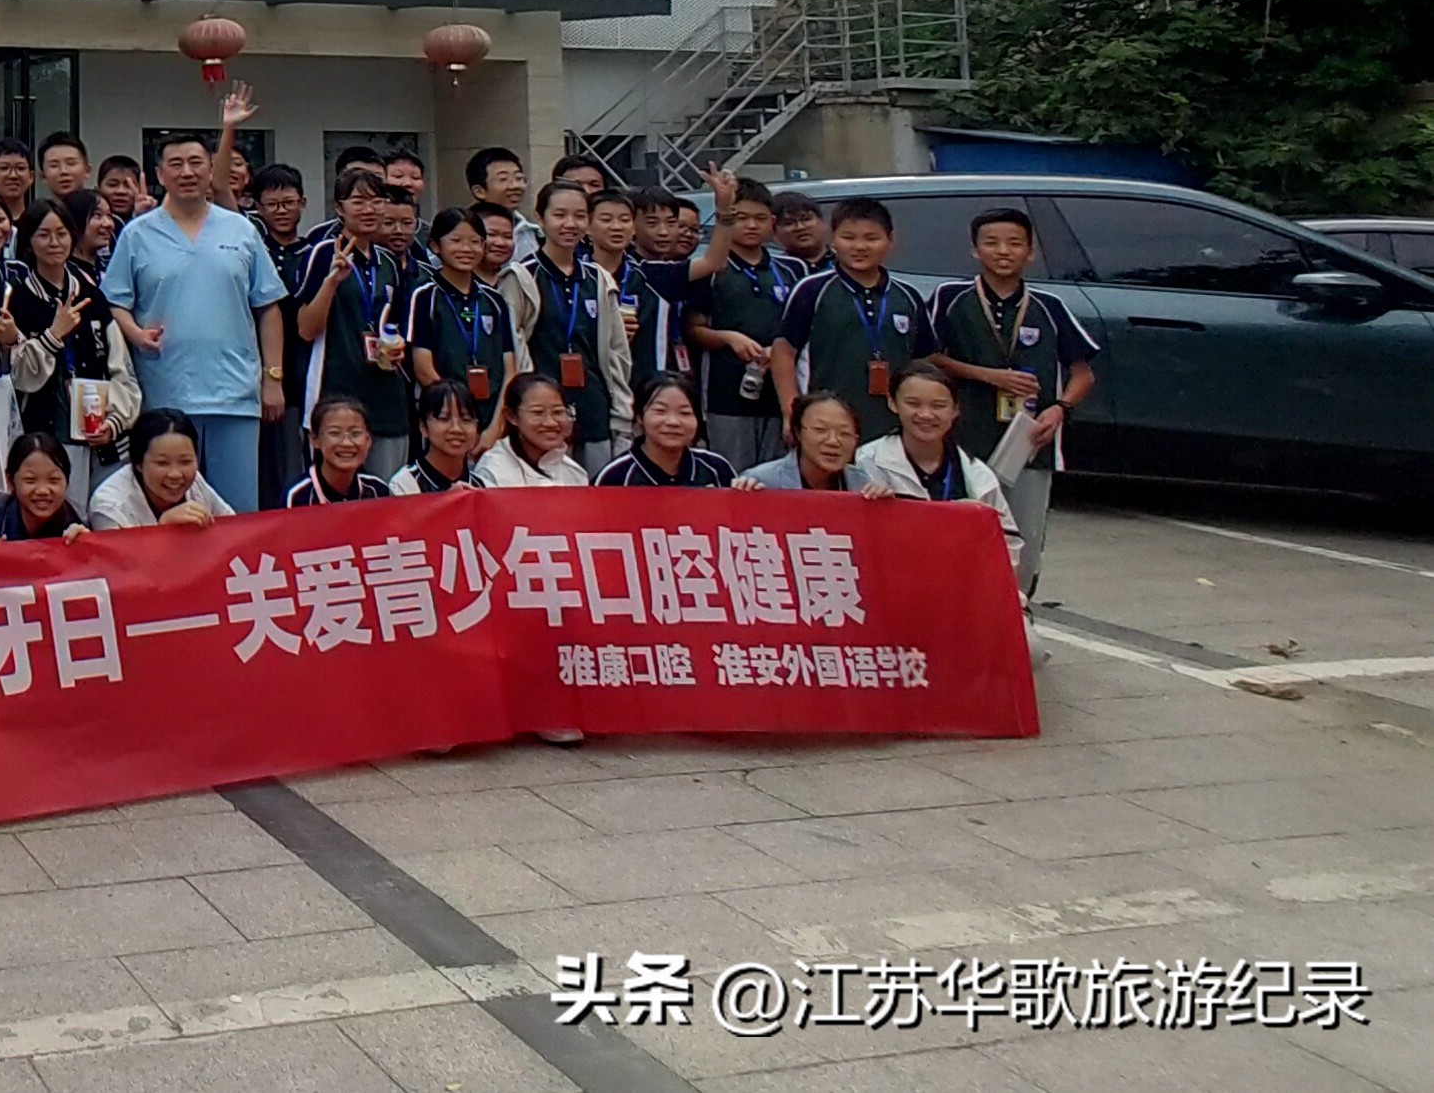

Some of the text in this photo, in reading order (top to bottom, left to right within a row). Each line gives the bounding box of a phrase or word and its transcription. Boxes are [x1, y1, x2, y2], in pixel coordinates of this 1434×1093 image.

[557, 643, 930, 688] 雅康口腔 淮安外国语学校
